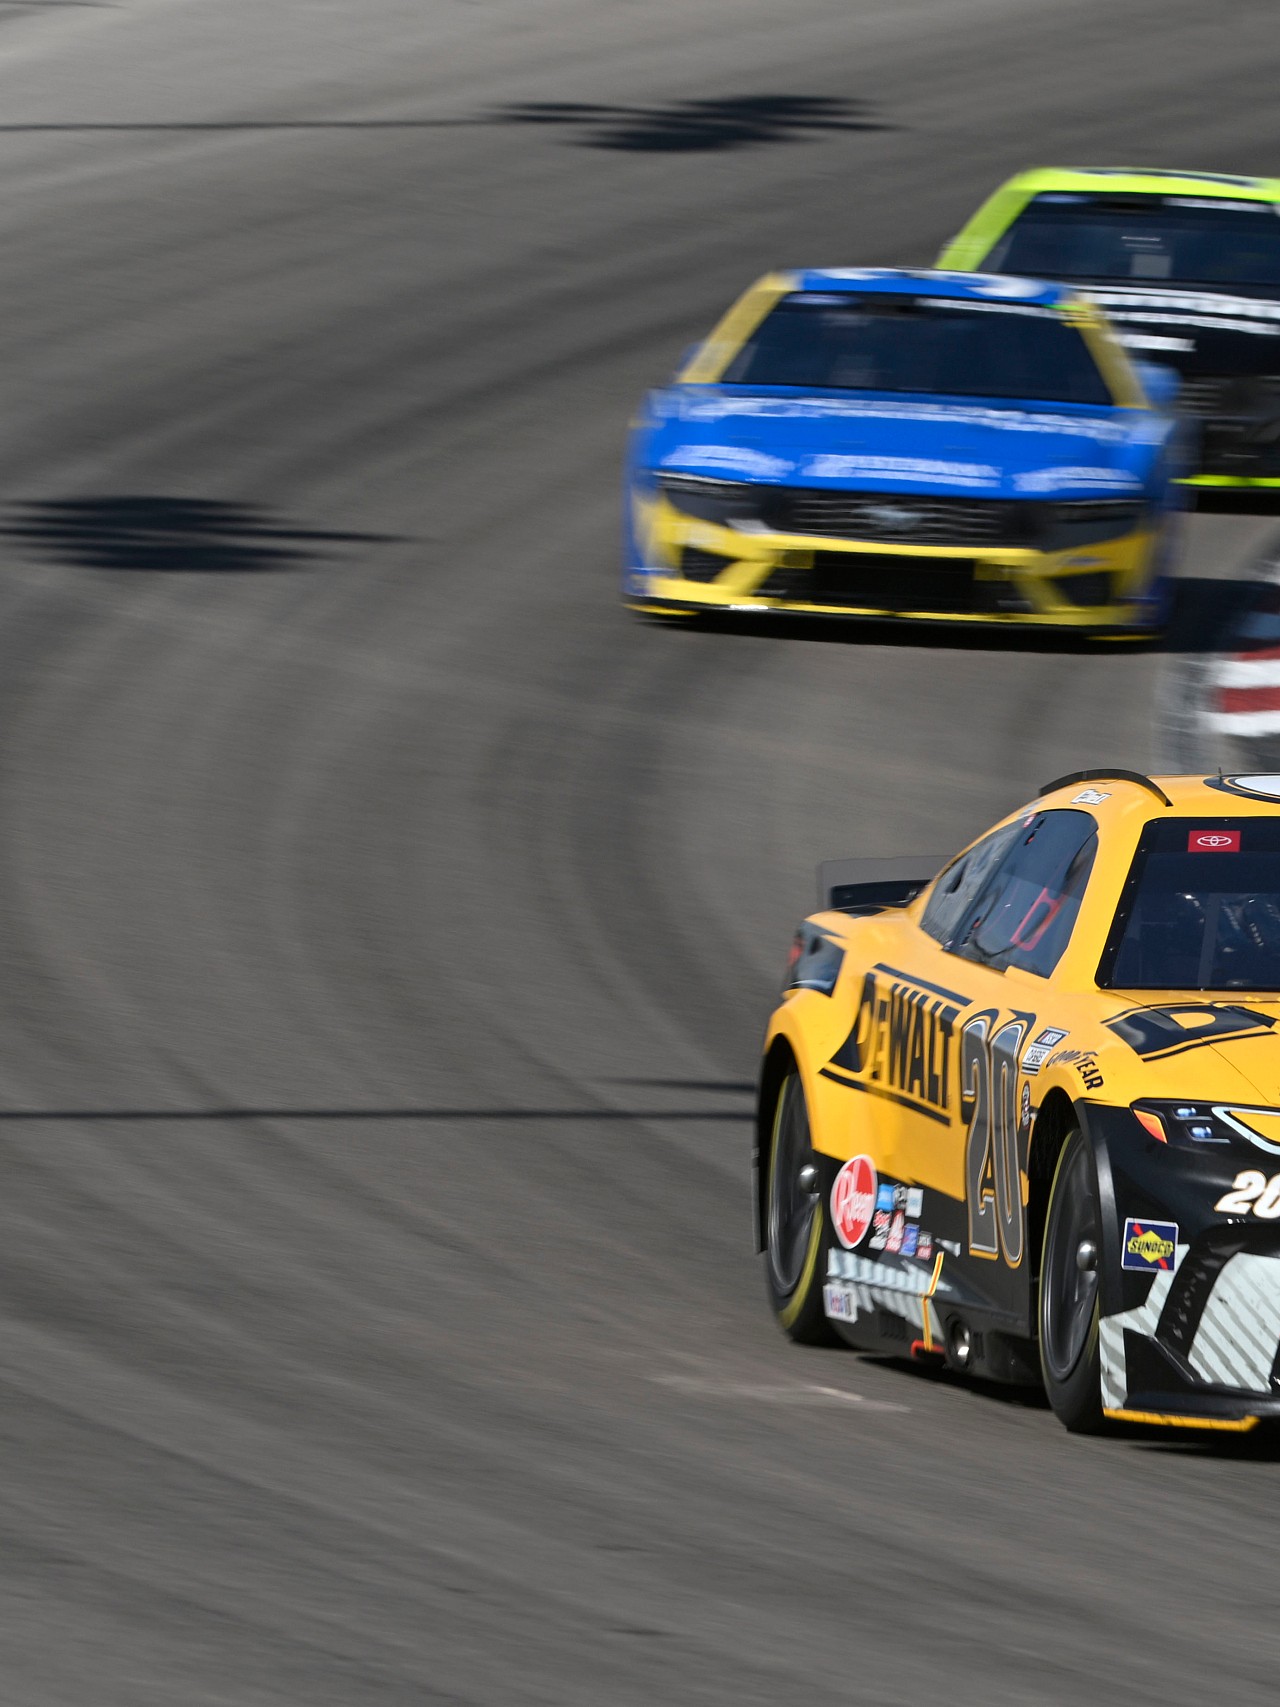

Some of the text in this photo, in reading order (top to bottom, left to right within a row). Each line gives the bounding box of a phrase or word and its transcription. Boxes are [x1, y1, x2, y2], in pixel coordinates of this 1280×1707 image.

[830, 971, 960, 1110] DEWALT
[960, 1009, 1034, 1269] 20
[1130, 1239, 1173, 1257] SUNOCO
